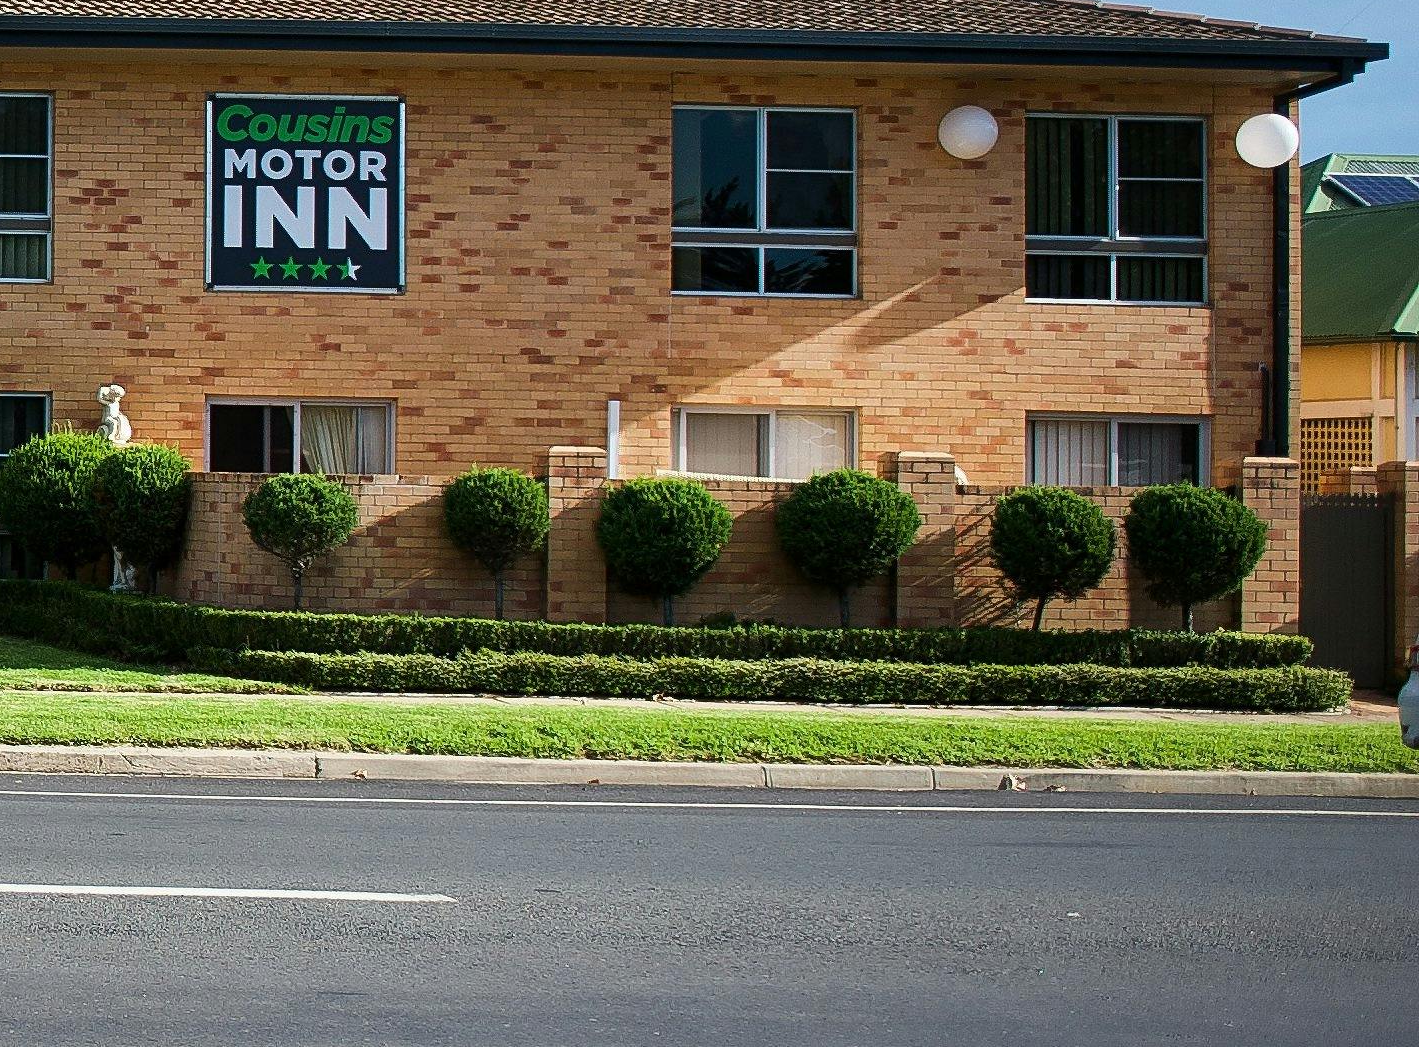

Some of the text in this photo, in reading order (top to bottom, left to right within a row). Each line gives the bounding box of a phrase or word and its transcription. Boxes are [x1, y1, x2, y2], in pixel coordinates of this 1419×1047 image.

[217, 104, 395, 144] Cousins
[224, 148, 388, 182] MOTOR
[223, 185, 388, 251] INN
